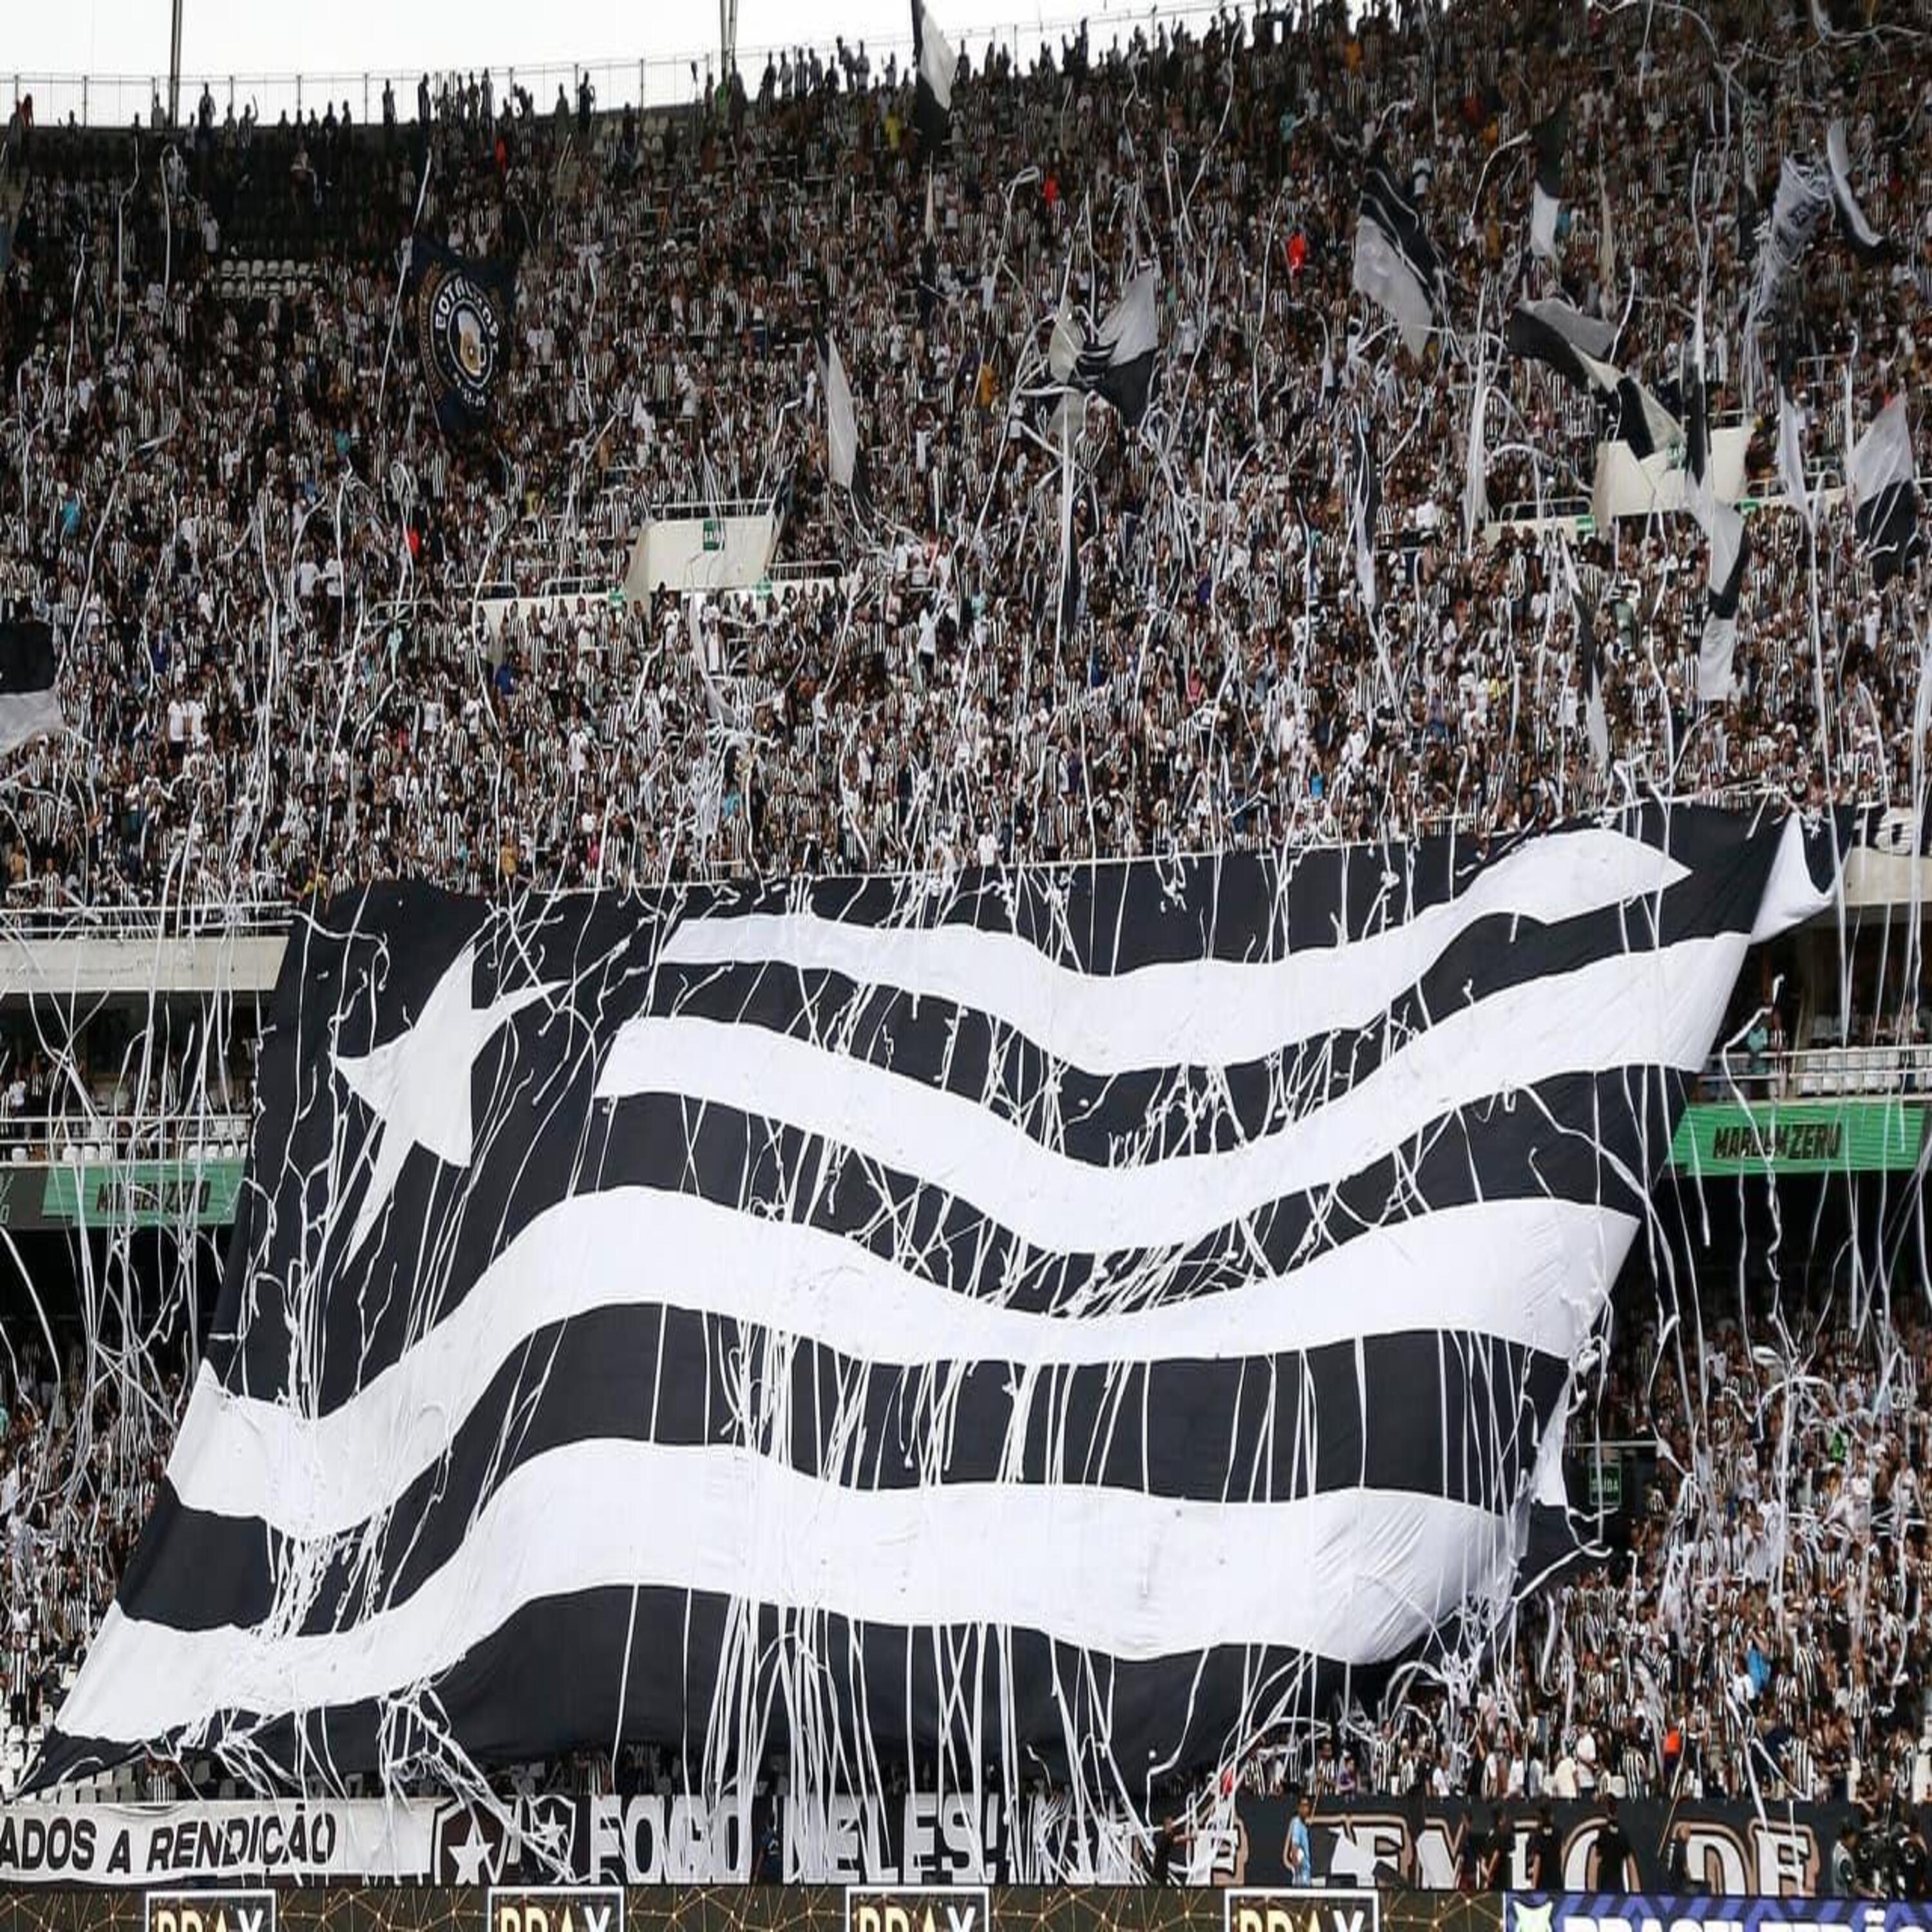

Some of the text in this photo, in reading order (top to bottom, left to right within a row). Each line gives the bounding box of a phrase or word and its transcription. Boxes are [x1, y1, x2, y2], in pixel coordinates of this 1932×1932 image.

[0, 1803, 337, 1874] ADOS A RENDIÇÃO
